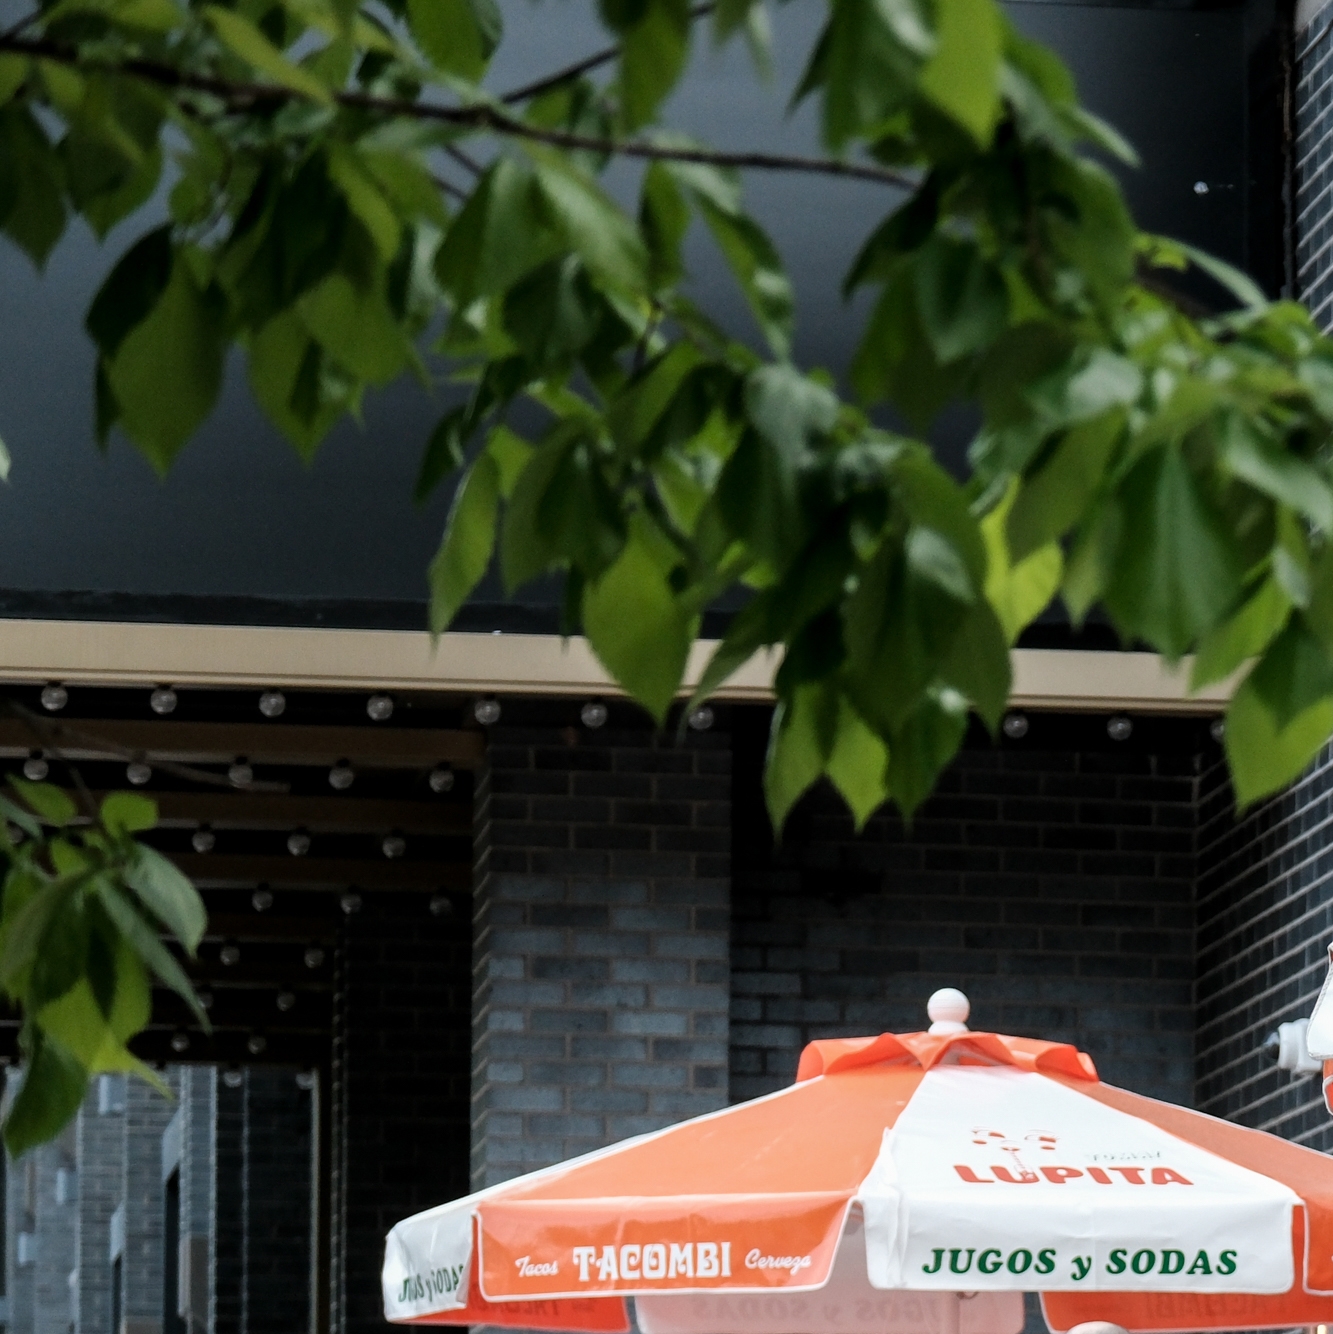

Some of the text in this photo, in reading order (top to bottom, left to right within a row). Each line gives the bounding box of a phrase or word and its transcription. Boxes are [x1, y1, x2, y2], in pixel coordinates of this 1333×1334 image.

[953, 1164, 1194, 1186] LUPITA
[515, 1241, 811, 1282] Tacos TACOMBI Cerveza
[922, 1248, 1239, 1281] JUGOS y SODAS
